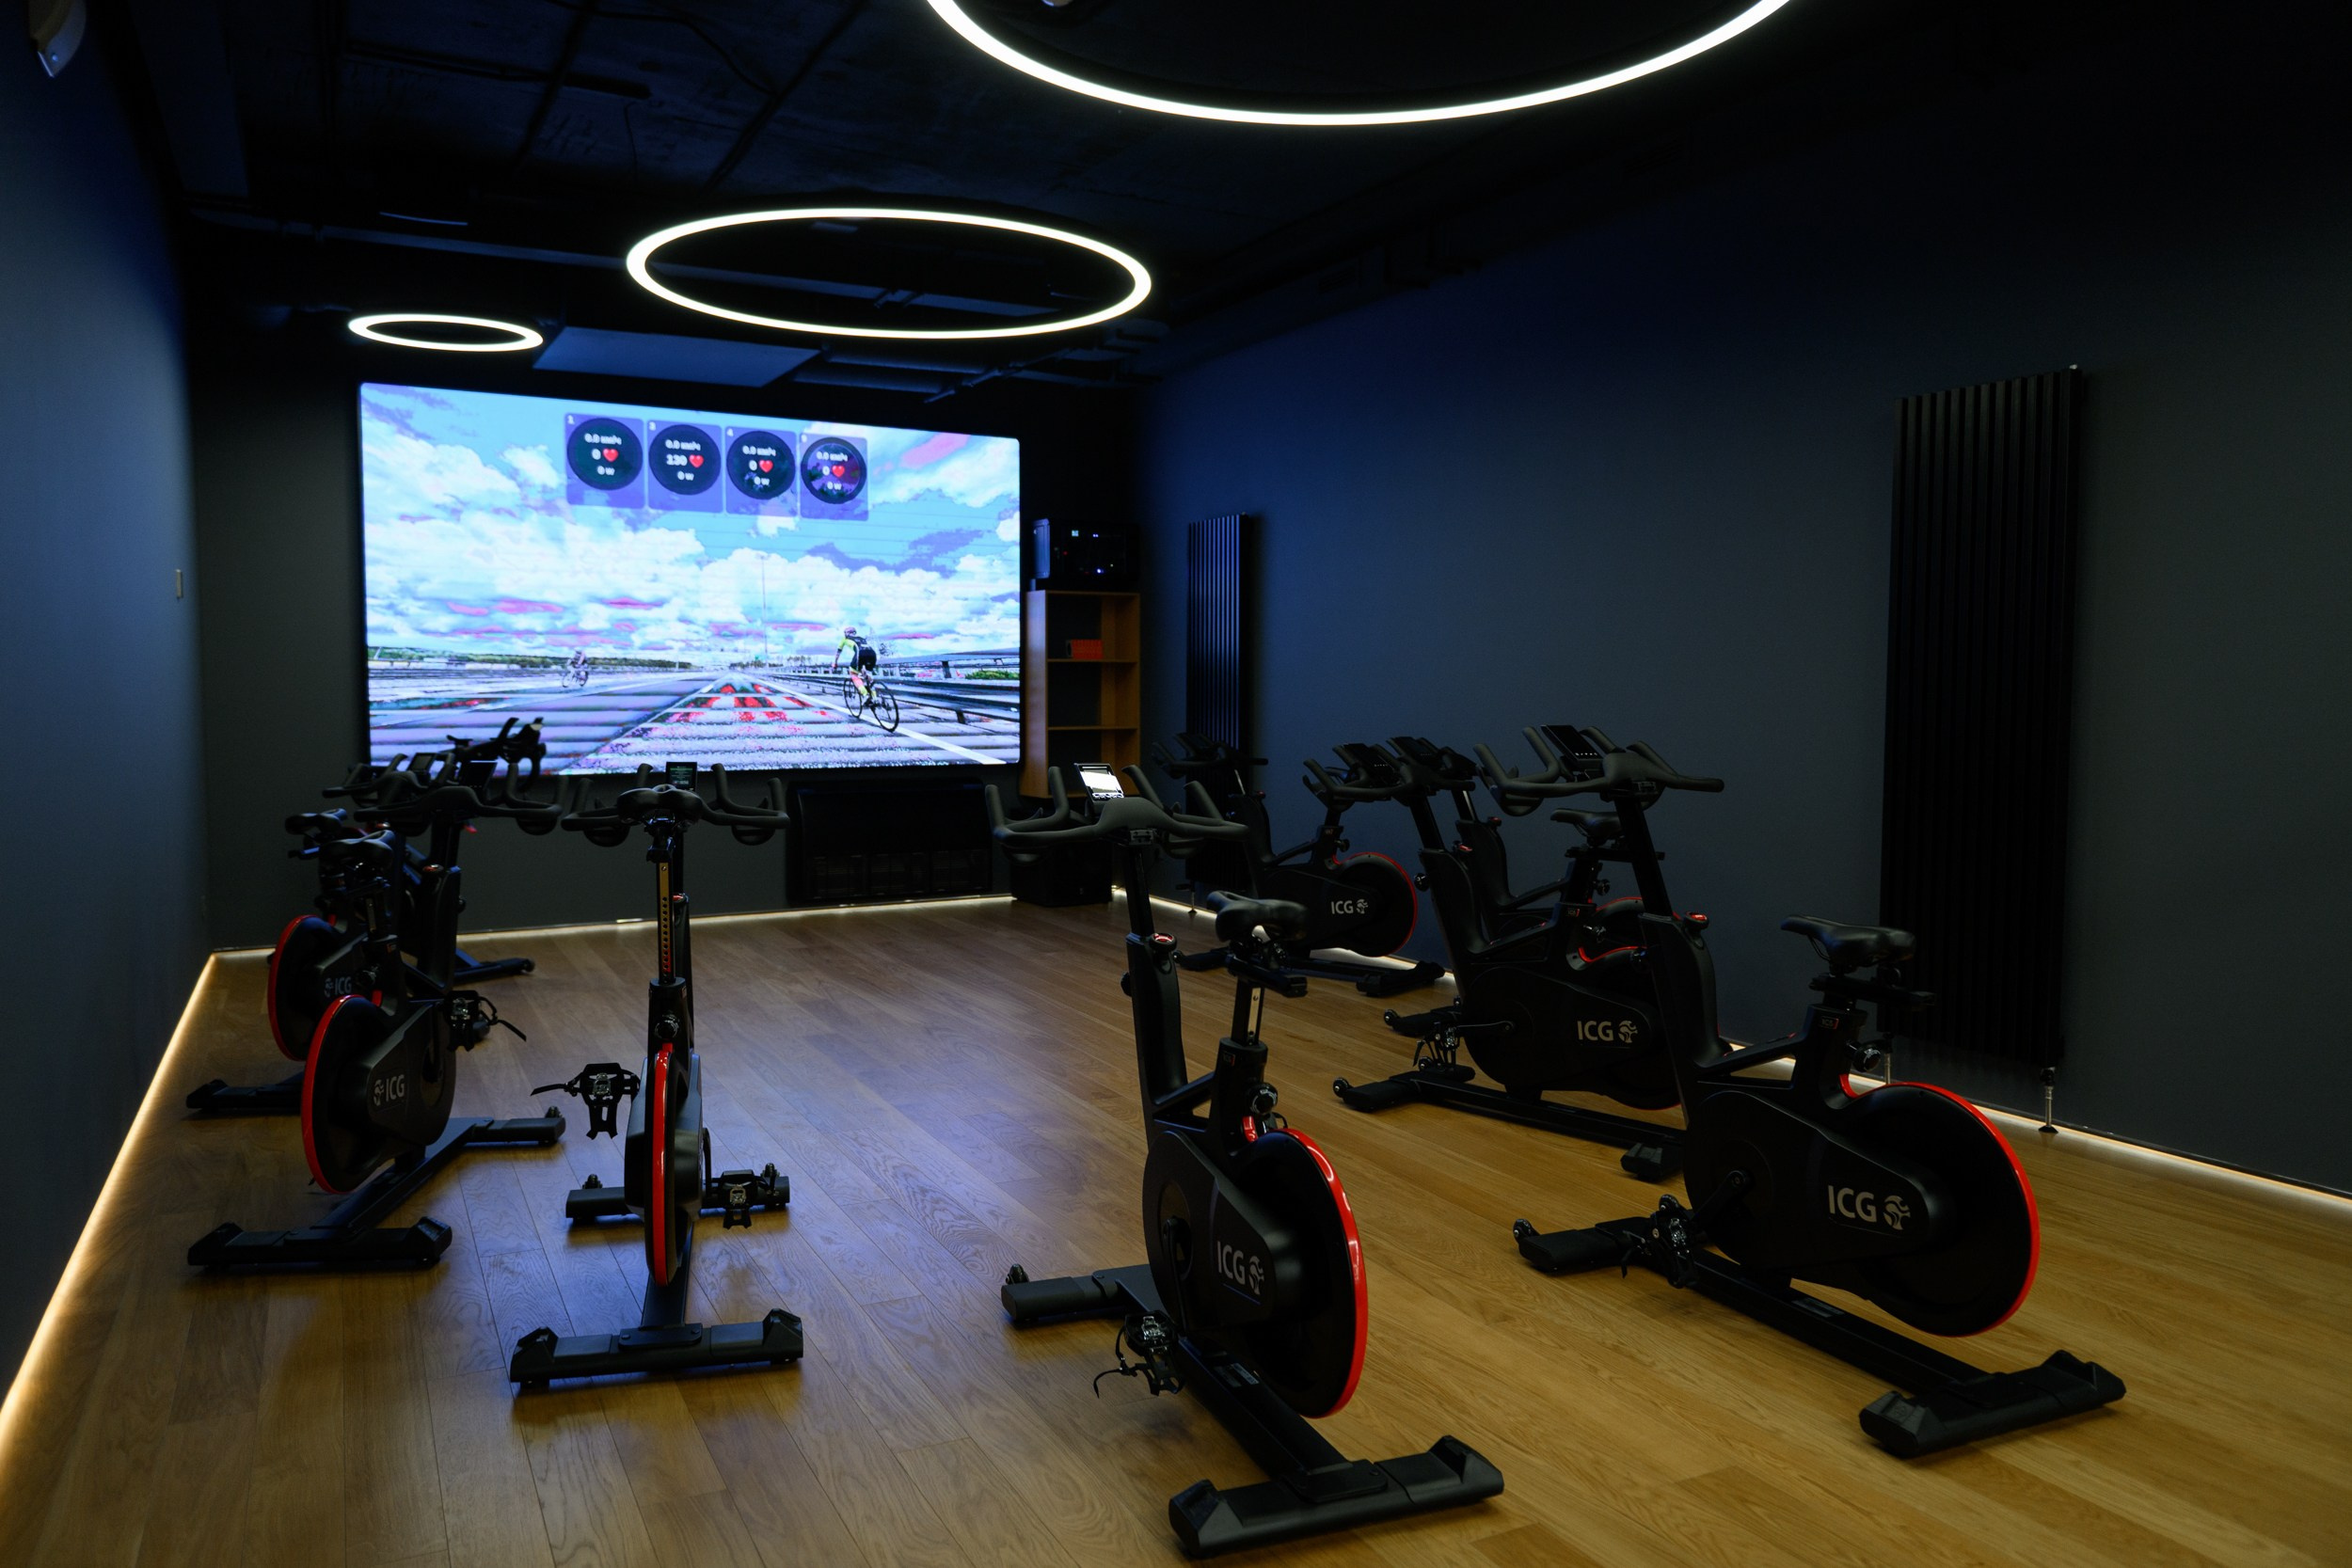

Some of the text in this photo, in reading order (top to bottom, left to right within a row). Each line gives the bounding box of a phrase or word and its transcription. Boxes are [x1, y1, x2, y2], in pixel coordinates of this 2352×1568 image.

[1330, 900, 1354, 915] ICG
[334, 975, 353, 995] ICG
[1577, 1020, 1614, 1041] ICG
[386, 1073, 405, 1102] ICG
[1827, 1184, 1877, 1223] ICG
[1216, 1240, 1246, 1286] ICG
